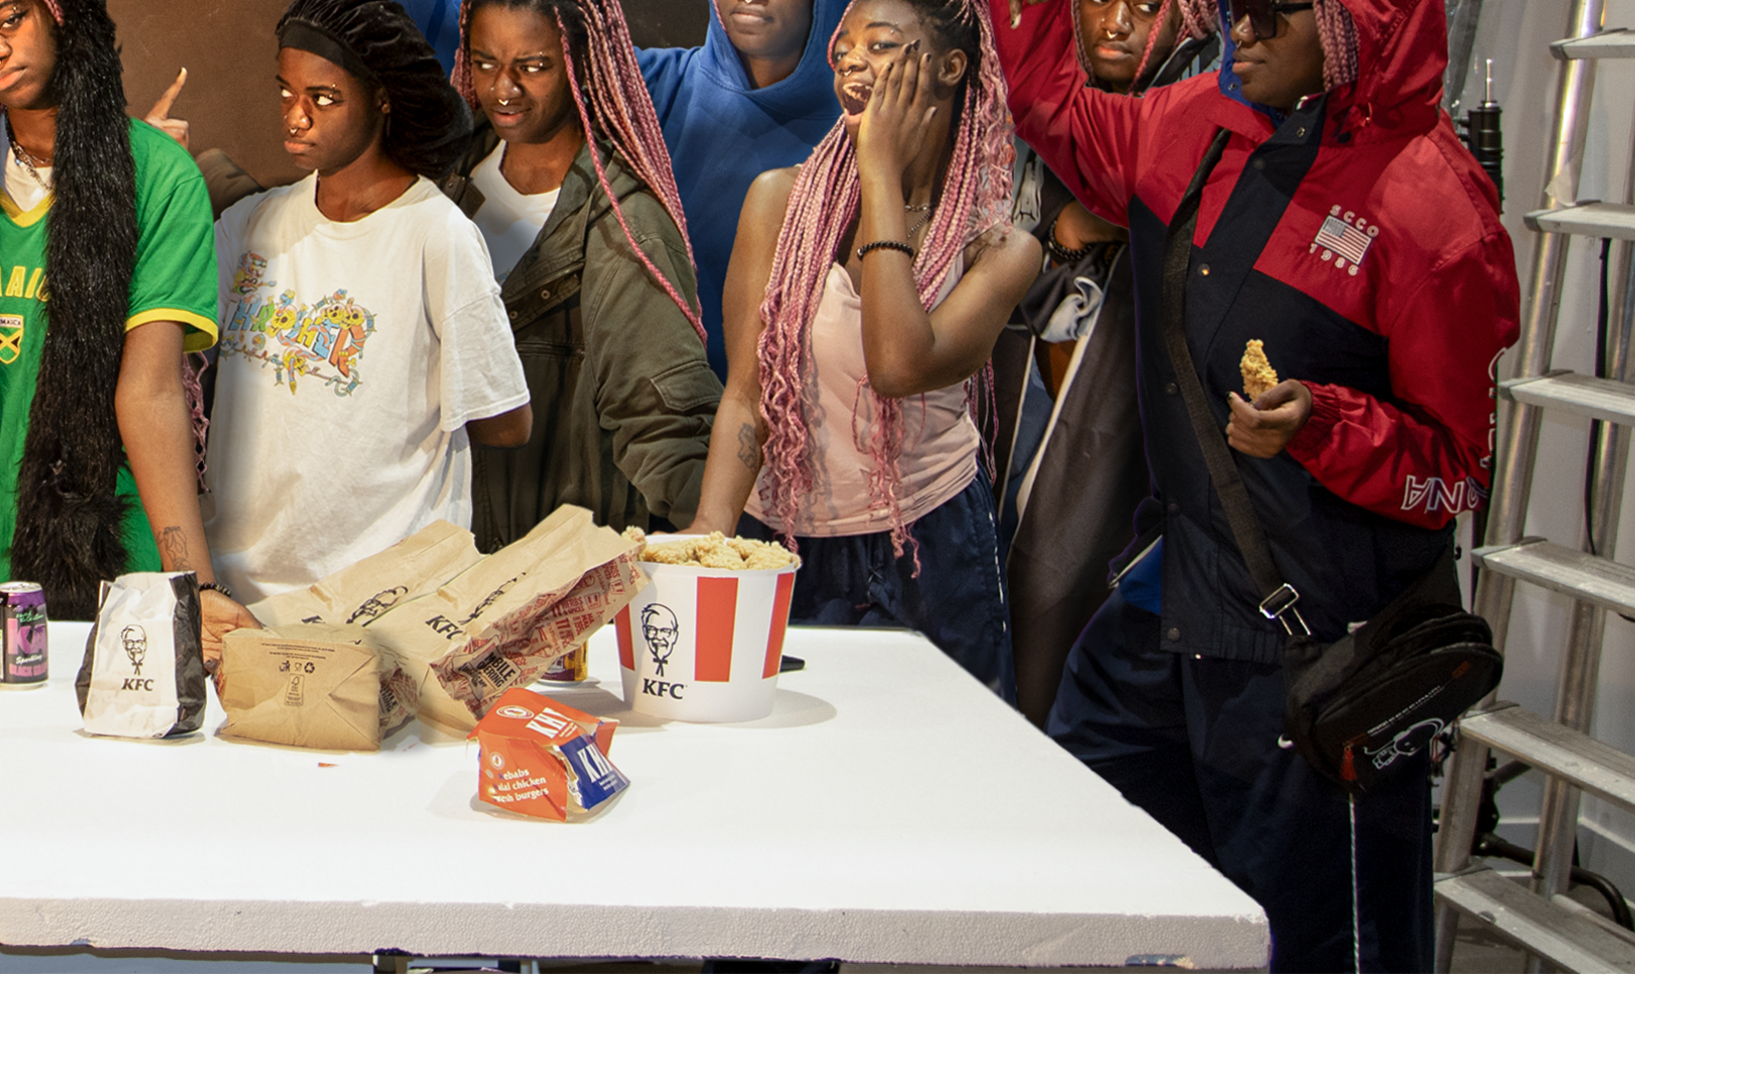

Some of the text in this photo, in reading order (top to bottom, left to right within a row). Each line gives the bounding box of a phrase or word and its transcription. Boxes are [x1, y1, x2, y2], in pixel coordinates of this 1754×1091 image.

[121, 678, 154, 692] KFC
[642, 678, 684, 700] KFC
[512, 777, 546, 790] chicken
[515, 788, 549, 801] burgers
